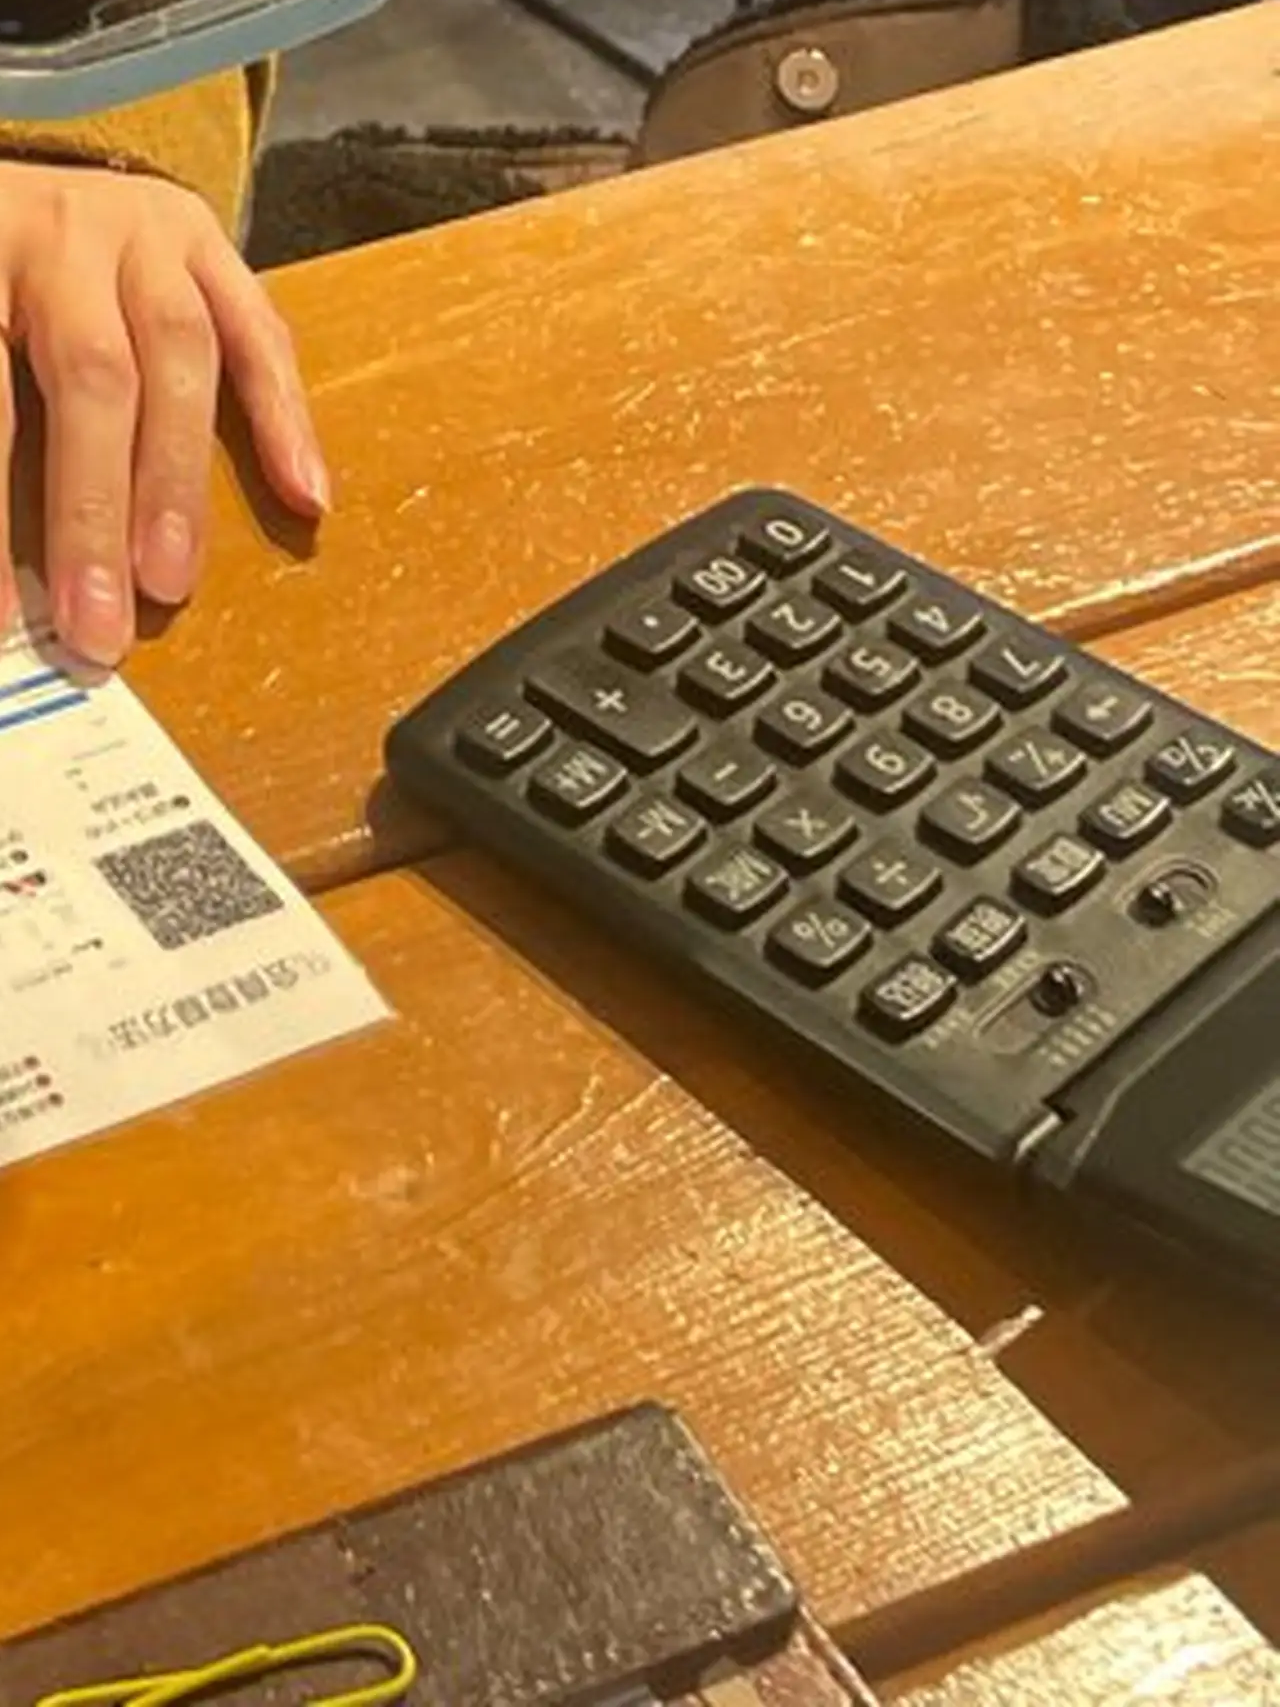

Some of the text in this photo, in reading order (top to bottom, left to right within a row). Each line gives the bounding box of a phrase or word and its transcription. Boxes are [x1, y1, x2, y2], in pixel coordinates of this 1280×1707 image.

[763, 521, 798, 546] 0
[692, 559, 747, 596] 00
[771, 603, 815, 633] 2
[913, 606, 949, 633] 4
[706, 652, 746, 681] 3
[851, 649, 891, 678] 5
[999, 649, 1040, 676] 7
[783, 701, 823, 730] 6
[931, 696, 971, 722] 8
[559, 755, 612, 791] M+
[861, 748, 901, 773] 9
[102, 957, 306, 1053] 会員登録方法
